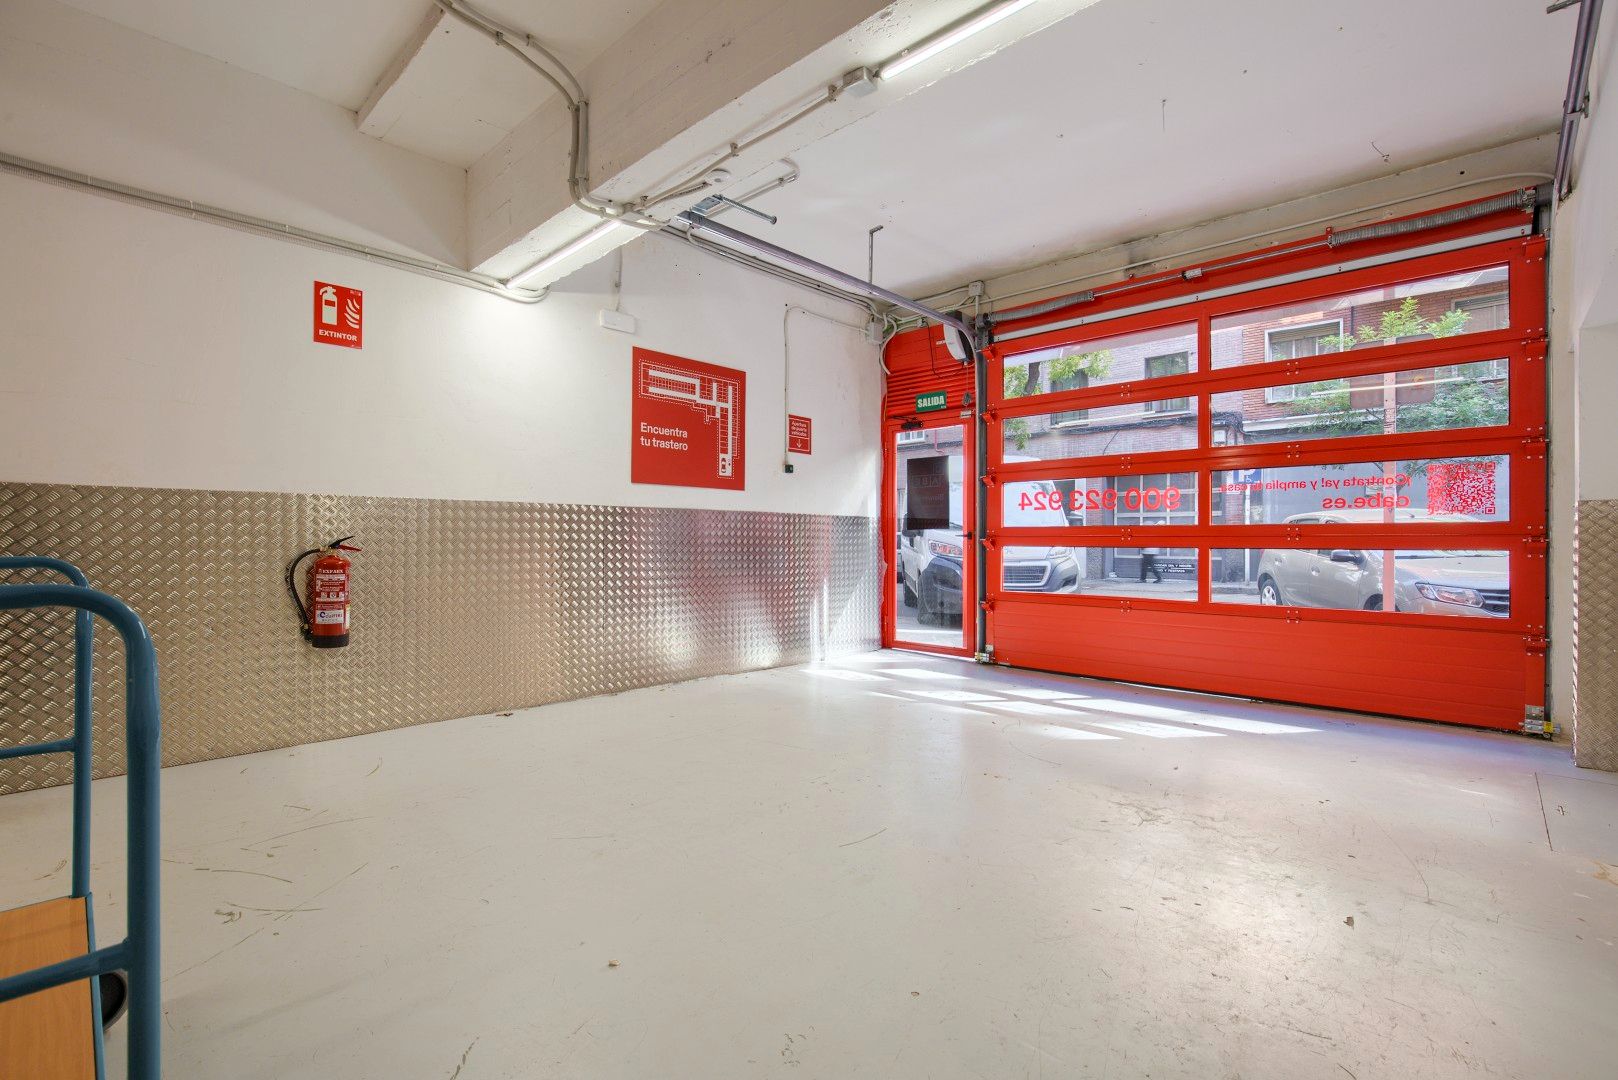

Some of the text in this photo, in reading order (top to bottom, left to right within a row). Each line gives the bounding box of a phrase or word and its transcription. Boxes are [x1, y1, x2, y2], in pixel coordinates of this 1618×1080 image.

[319, 330, 357, 341] EXTINTOR
[917, 395, 945, 408] SALIDA
[640, 422, 688, 439] Encuentra
[640, 437, 688, 451] tu trastero
